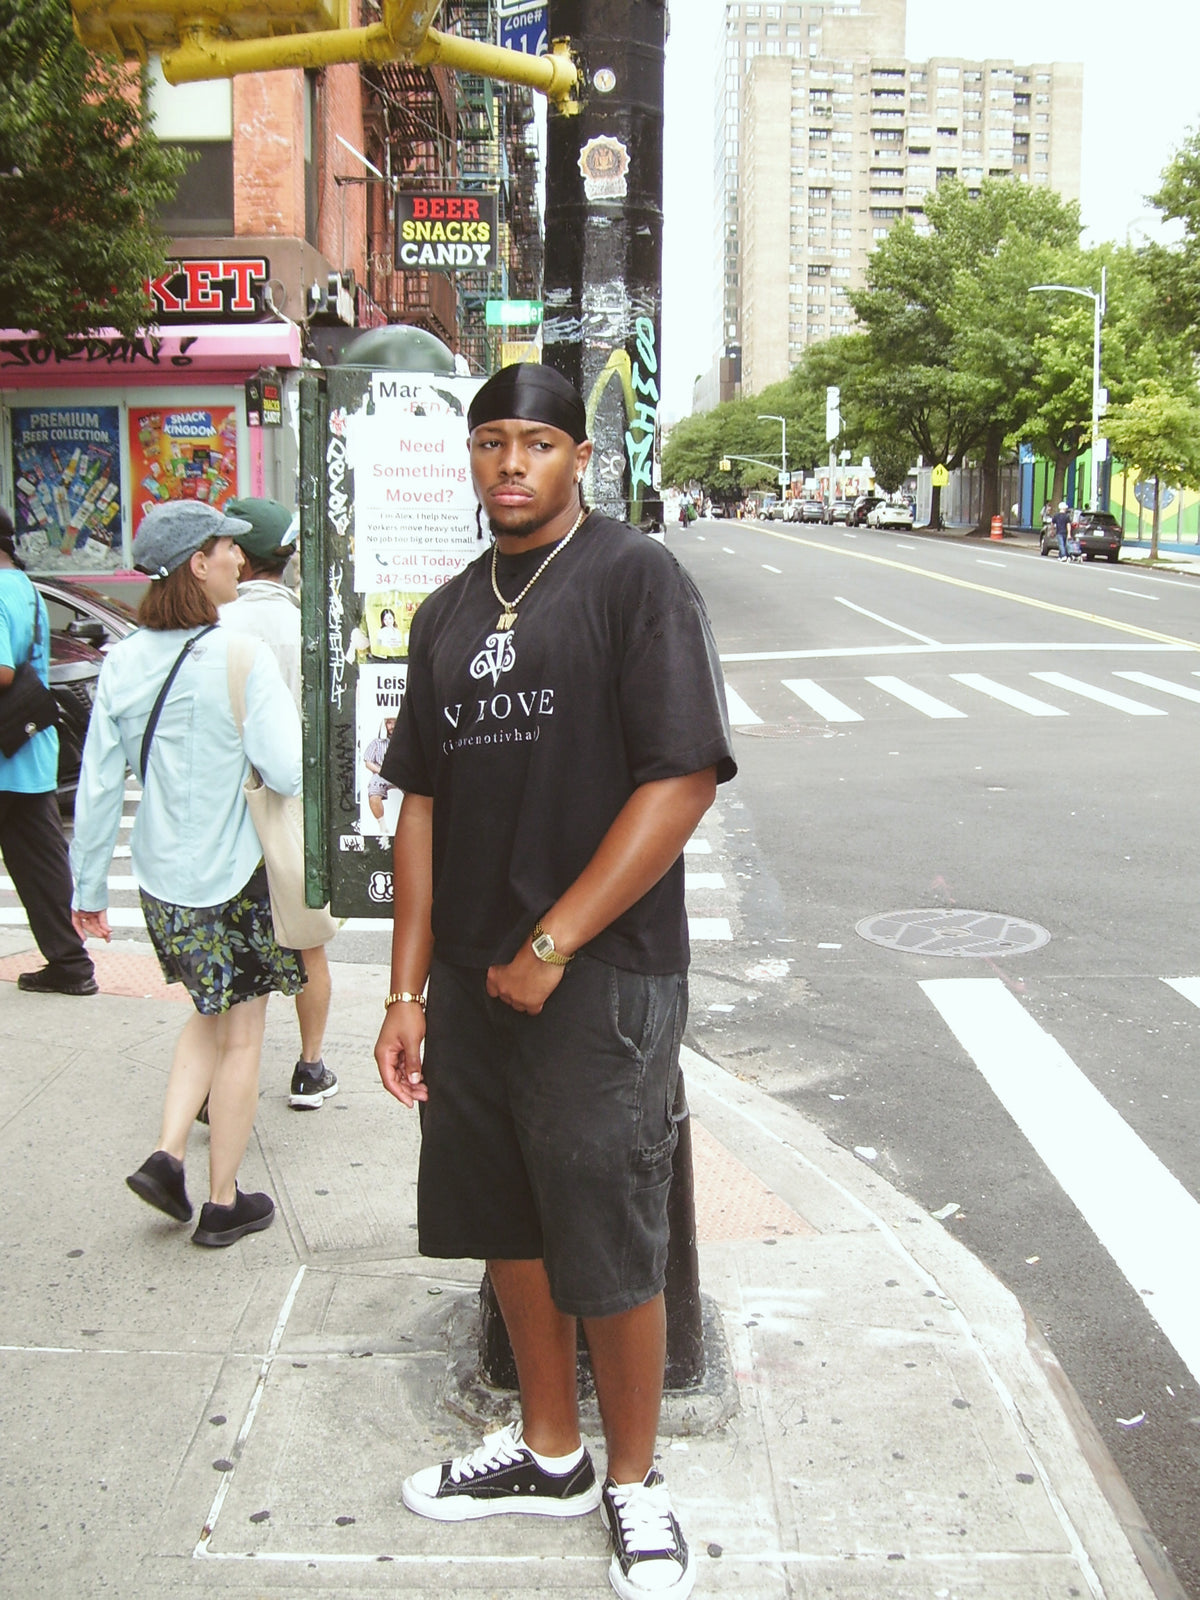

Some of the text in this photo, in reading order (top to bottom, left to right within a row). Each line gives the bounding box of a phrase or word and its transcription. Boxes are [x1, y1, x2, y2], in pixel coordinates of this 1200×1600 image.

[504, 8, 542, 31] Zone#
[413, 197, 479, 219] BEER
[402, 220, 490, 242] SNACKS
[401, 243, 491, 266] CANDY
[143, 259, 267, 312] KET
[30, 412, 99, 428] PREMIUM
[170, 411, 206, 423] SNACK
[22, 428, 109, 443] BEER COLLECTION
[163, 424, 217, 437] KINGDOM
[400, 440, 444, 453] Need
[373, 464, 467, 482] Something
[386, 489, 454, 503] Moved?
[421, 512, 439, 522] help
[441, 512, 459, 521] New
[368, 523, 398, 532] Yorkers
[425, 525, 448, 534] heavy
[366, 535, 378, 543] No
[379, 535, 393, 545] job
[410, 535, 423, 545] big
[435, 536, 449, 544] too
[392, 554, 466, 569] Call Today:
[377, 675, 405, 690] Leis
